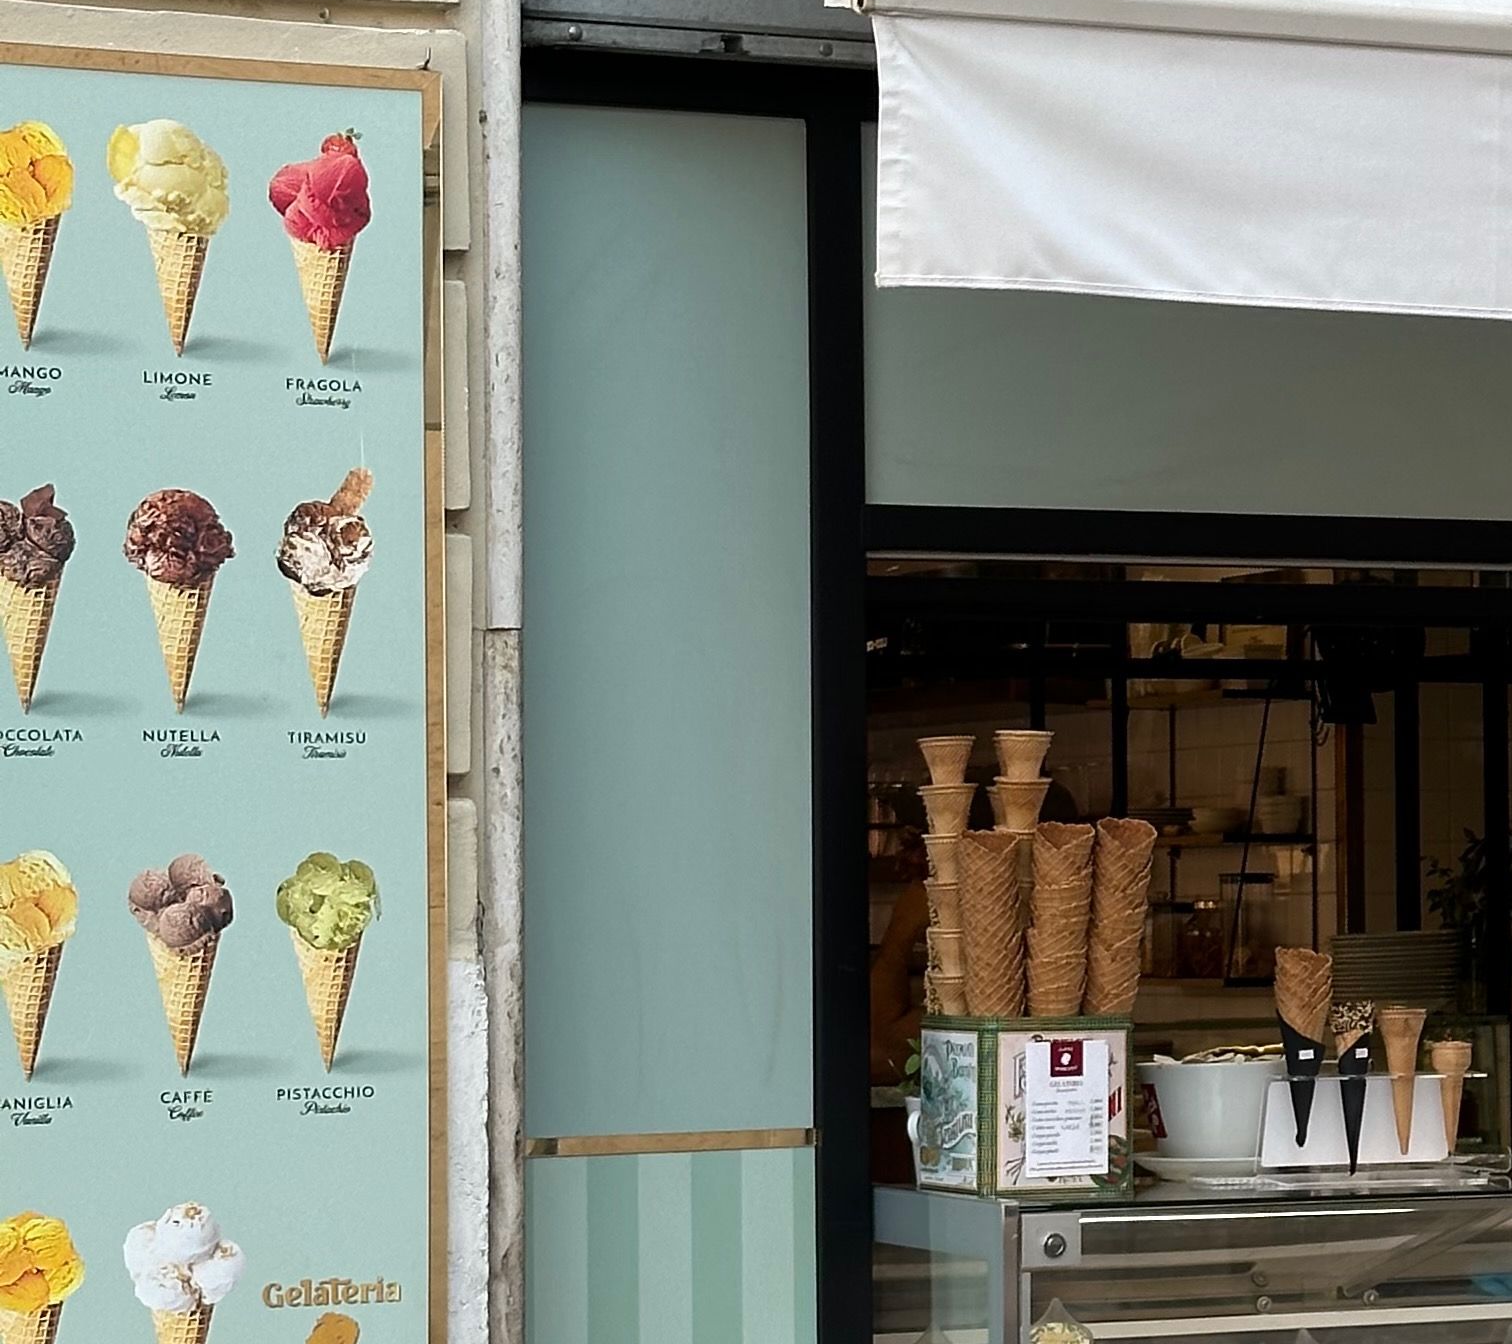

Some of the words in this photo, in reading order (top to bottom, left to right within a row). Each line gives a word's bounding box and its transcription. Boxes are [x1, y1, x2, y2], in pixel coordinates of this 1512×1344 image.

[143, 370, 213, 386] LIMONE
[286, 377, 362, 392] FRAGOLA
[143, 729, 220, 742] NUTELLA
[277, 1086, 375, 1100] PISTACCHIO
[0, 1096, 73, 1110] ANIGLIA
[262, 1276, 402, 1308] Gelateria
